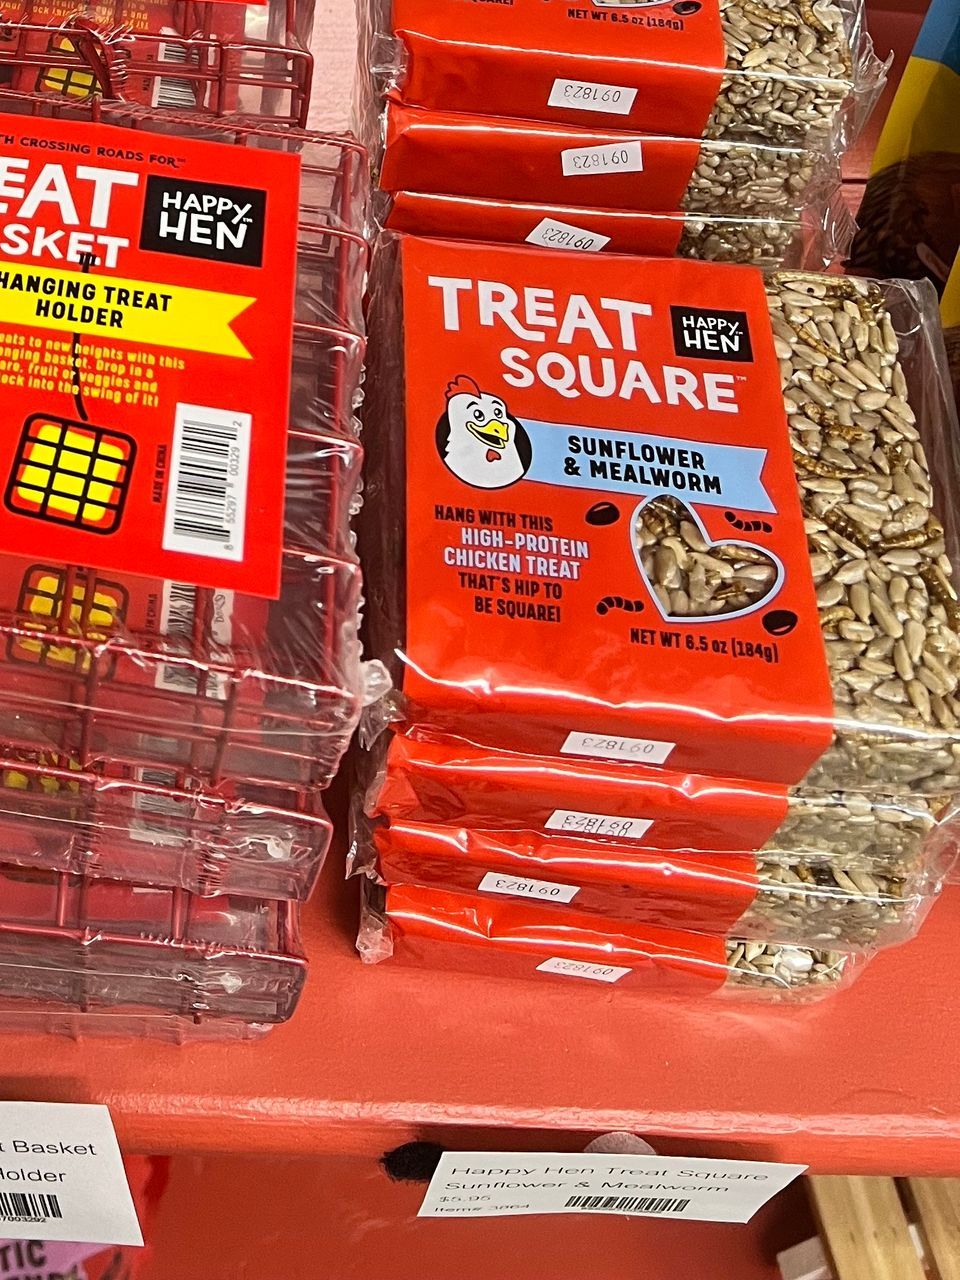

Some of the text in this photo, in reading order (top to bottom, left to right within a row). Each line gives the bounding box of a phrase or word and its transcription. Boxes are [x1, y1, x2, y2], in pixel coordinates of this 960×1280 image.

[563, 83, 623, 104] 091823
[20, 137, 91, 155] CROSSING
[97, 146, 144, 162] ROADS
[572, 148, 629, 170] 091823
[103, 285, 172, 312] TREAT
[35, 298, 125, 329] HOLDER
[427, 276, 652, 354] TREAT
[29, 336, 42, 349] to
[45, 340, 71, 353] new
[74, 343, 123, 361] heights
[127, 350, 156, 366] with
[159, 355, 185, 370] this
[96, 359, 125, 376] Drop
[567, 434, 706, 471] SUNFLOWER
[563, 456, 722, 495] & MEALWORM
[433, 503, 554, 533] HANG WITH THIS
[460, 527, 590, 560] HIGH-PROTEIN
[443, 545, 581, 581] CHICKEN TREAT
[458, 571, 563, 600] THAT'S HIP TO
[473, 595, 562, 624] BE SQUARE!
[630, 627, 779, 664] NET WT 6.5 oz (184g)
[581, 735, 655, 756] 091823
[494, 877, 561, 898] 091823
[11, 1138, 97, 1157] Basket
[444, 1181, 571, 1191] Sunflower
[601, 1182, 730, 1193] Mealworm
[450, 1166, 770, 1182] Happy Hen Treat Square
